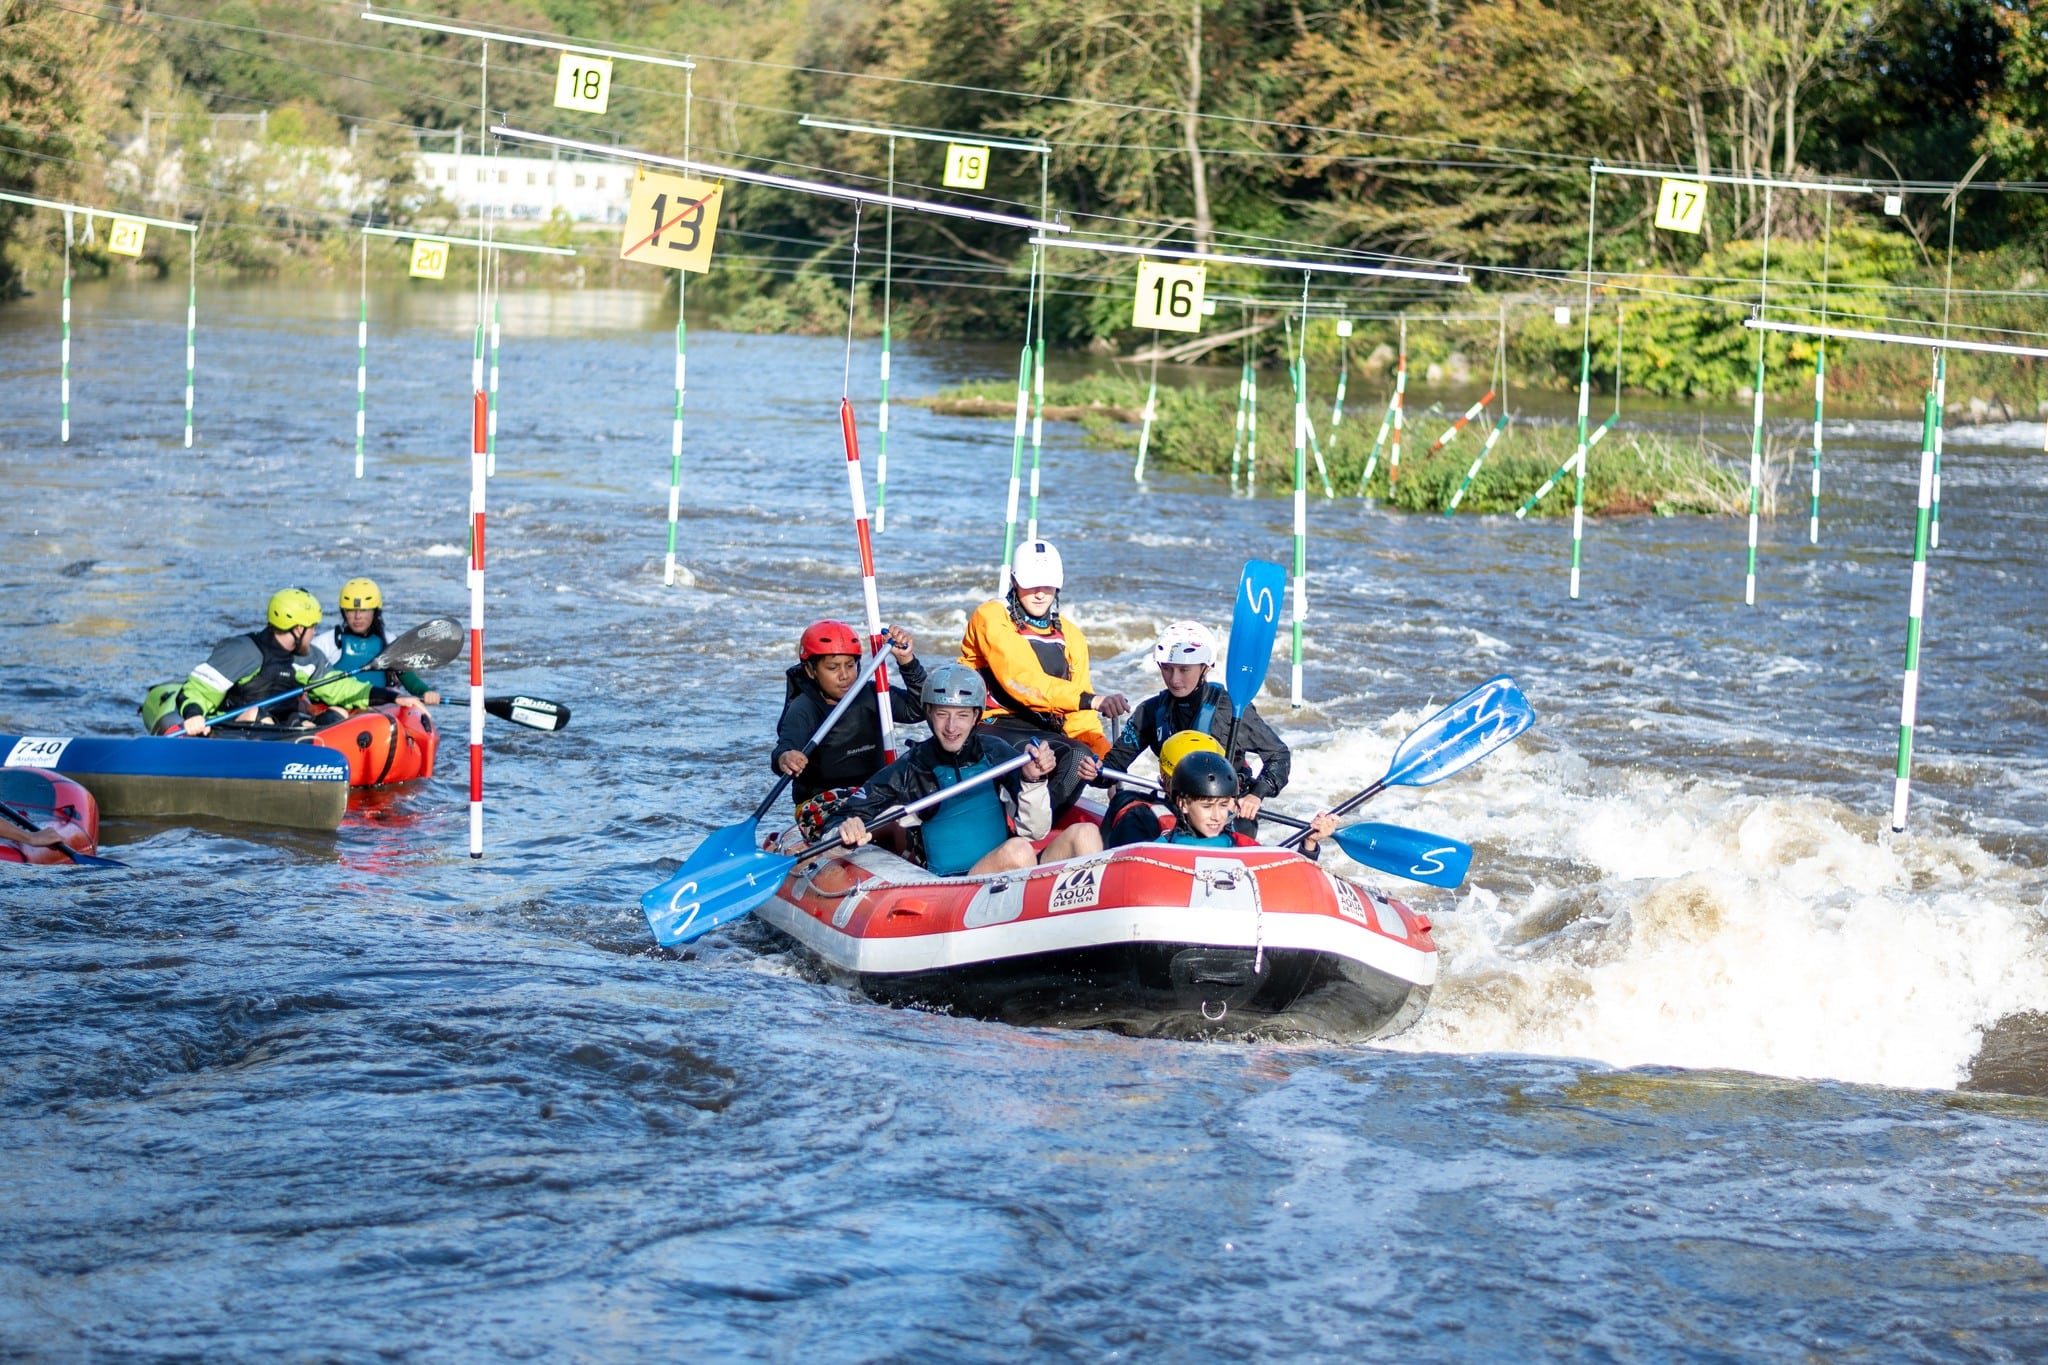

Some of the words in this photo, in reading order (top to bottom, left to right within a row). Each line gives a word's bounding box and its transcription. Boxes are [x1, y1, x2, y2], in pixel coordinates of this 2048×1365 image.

[572, 68, 601, 100] 18
[958, 154, 980, 180] 19
[1671, 191, 1697, 220] 17
[651, 193, 705, 252] 13
[115, 226, 137, 248] 21
[417, 247, 442, 270] 20
[1152, 276, 1194, 318] 16
[17, 741, 62, 755] 740
[1053, 886, 1095, 902] AQUA
[1053, 895, 1093, 908] DESIGN
